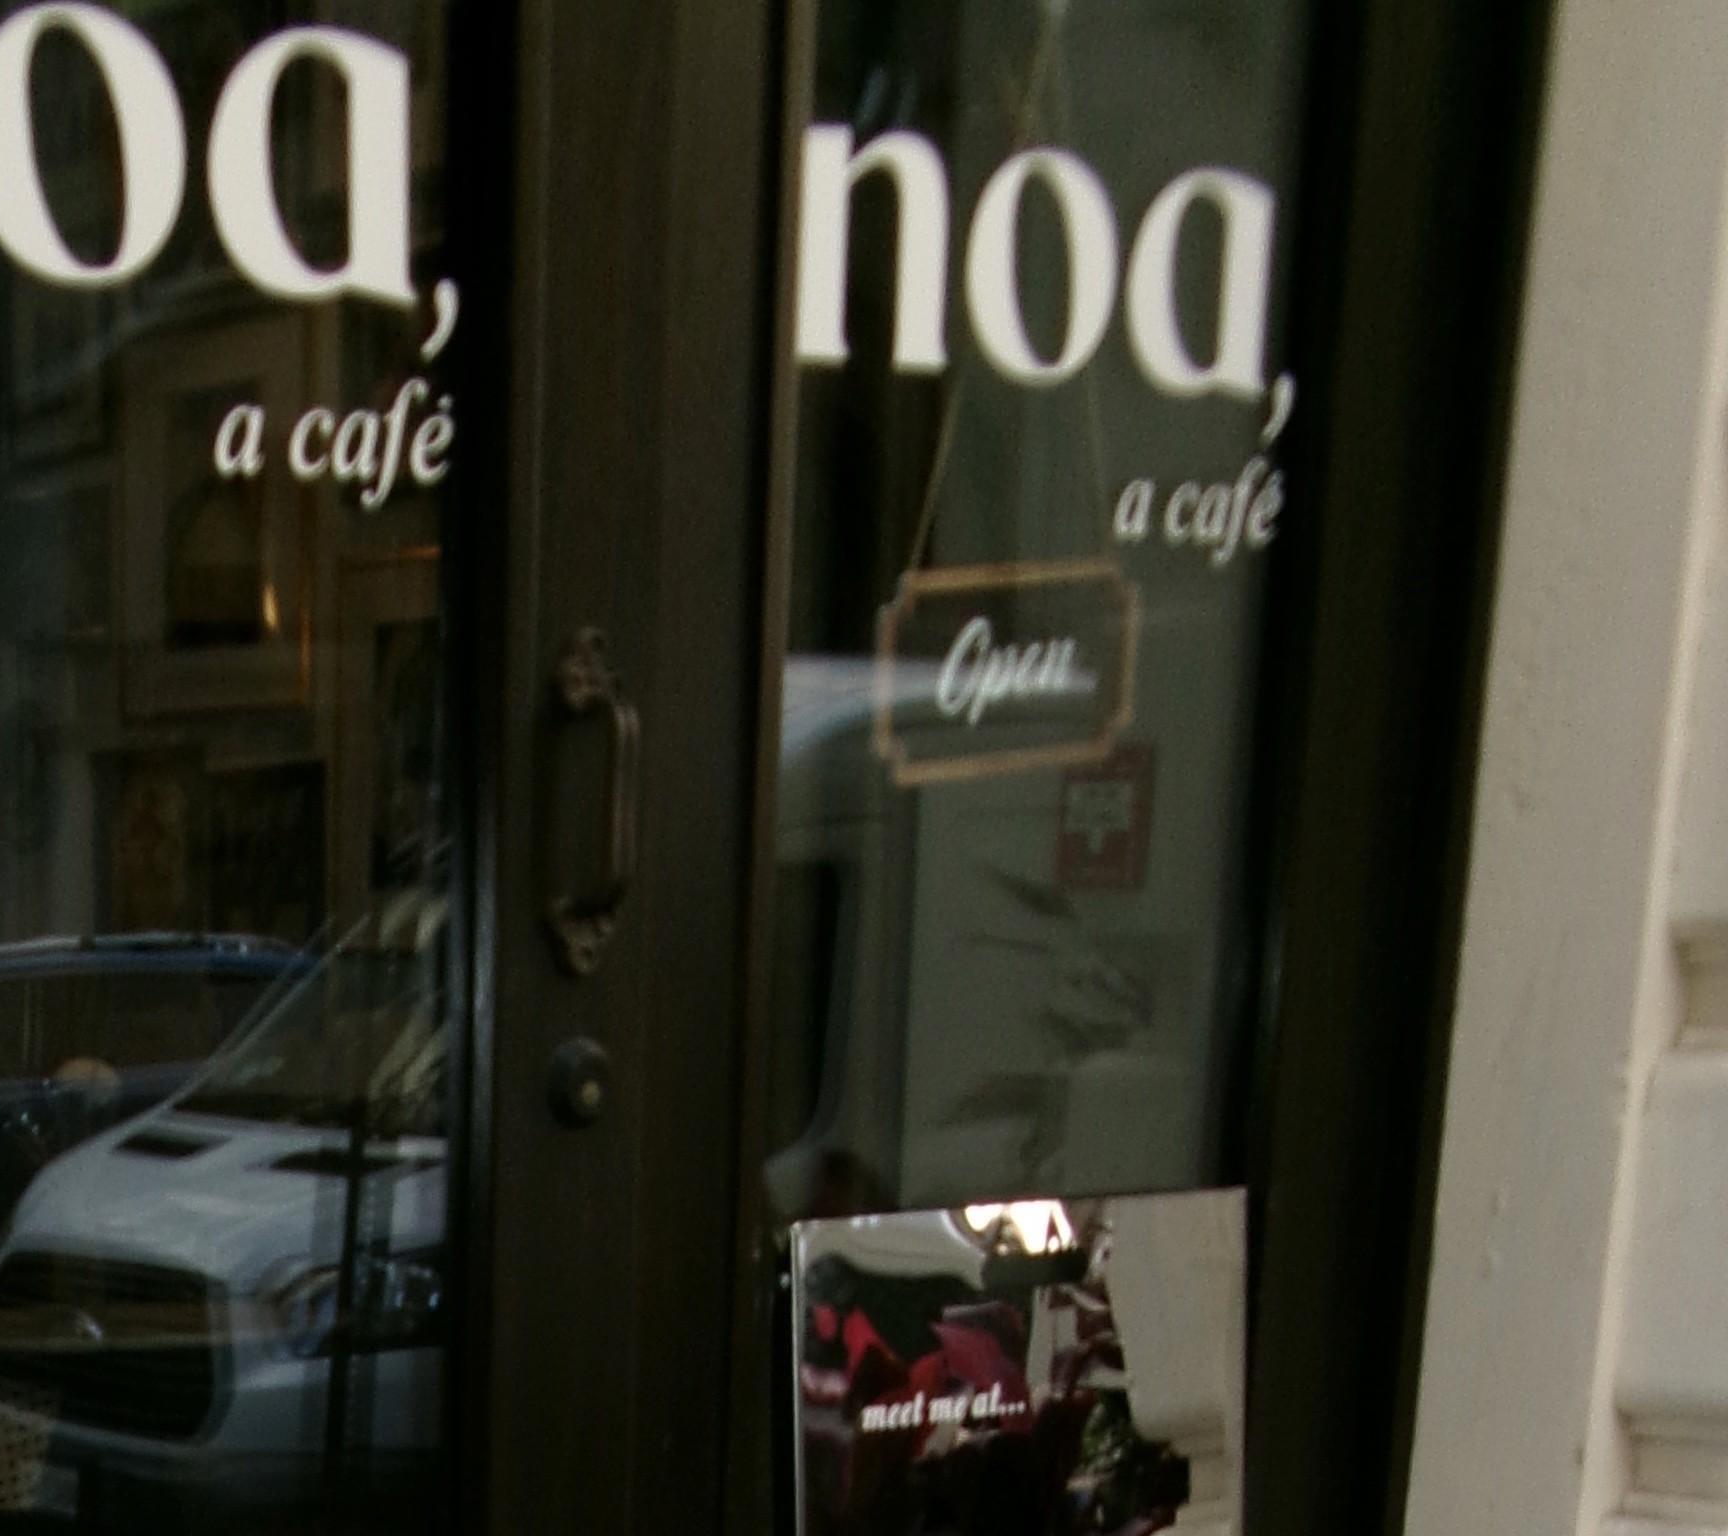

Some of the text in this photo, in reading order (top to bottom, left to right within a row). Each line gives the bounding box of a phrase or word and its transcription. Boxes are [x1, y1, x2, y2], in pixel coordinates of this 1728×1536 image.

[794, 119, 1297, 441] noa,
[213, 377, 457, 510] a café
[1112, 455, 1286, 566] a café
[936, 614, 1075, 726] Open
[860, 1389, 926, 1433] meet
[927, 1394, 970, 1425] me
